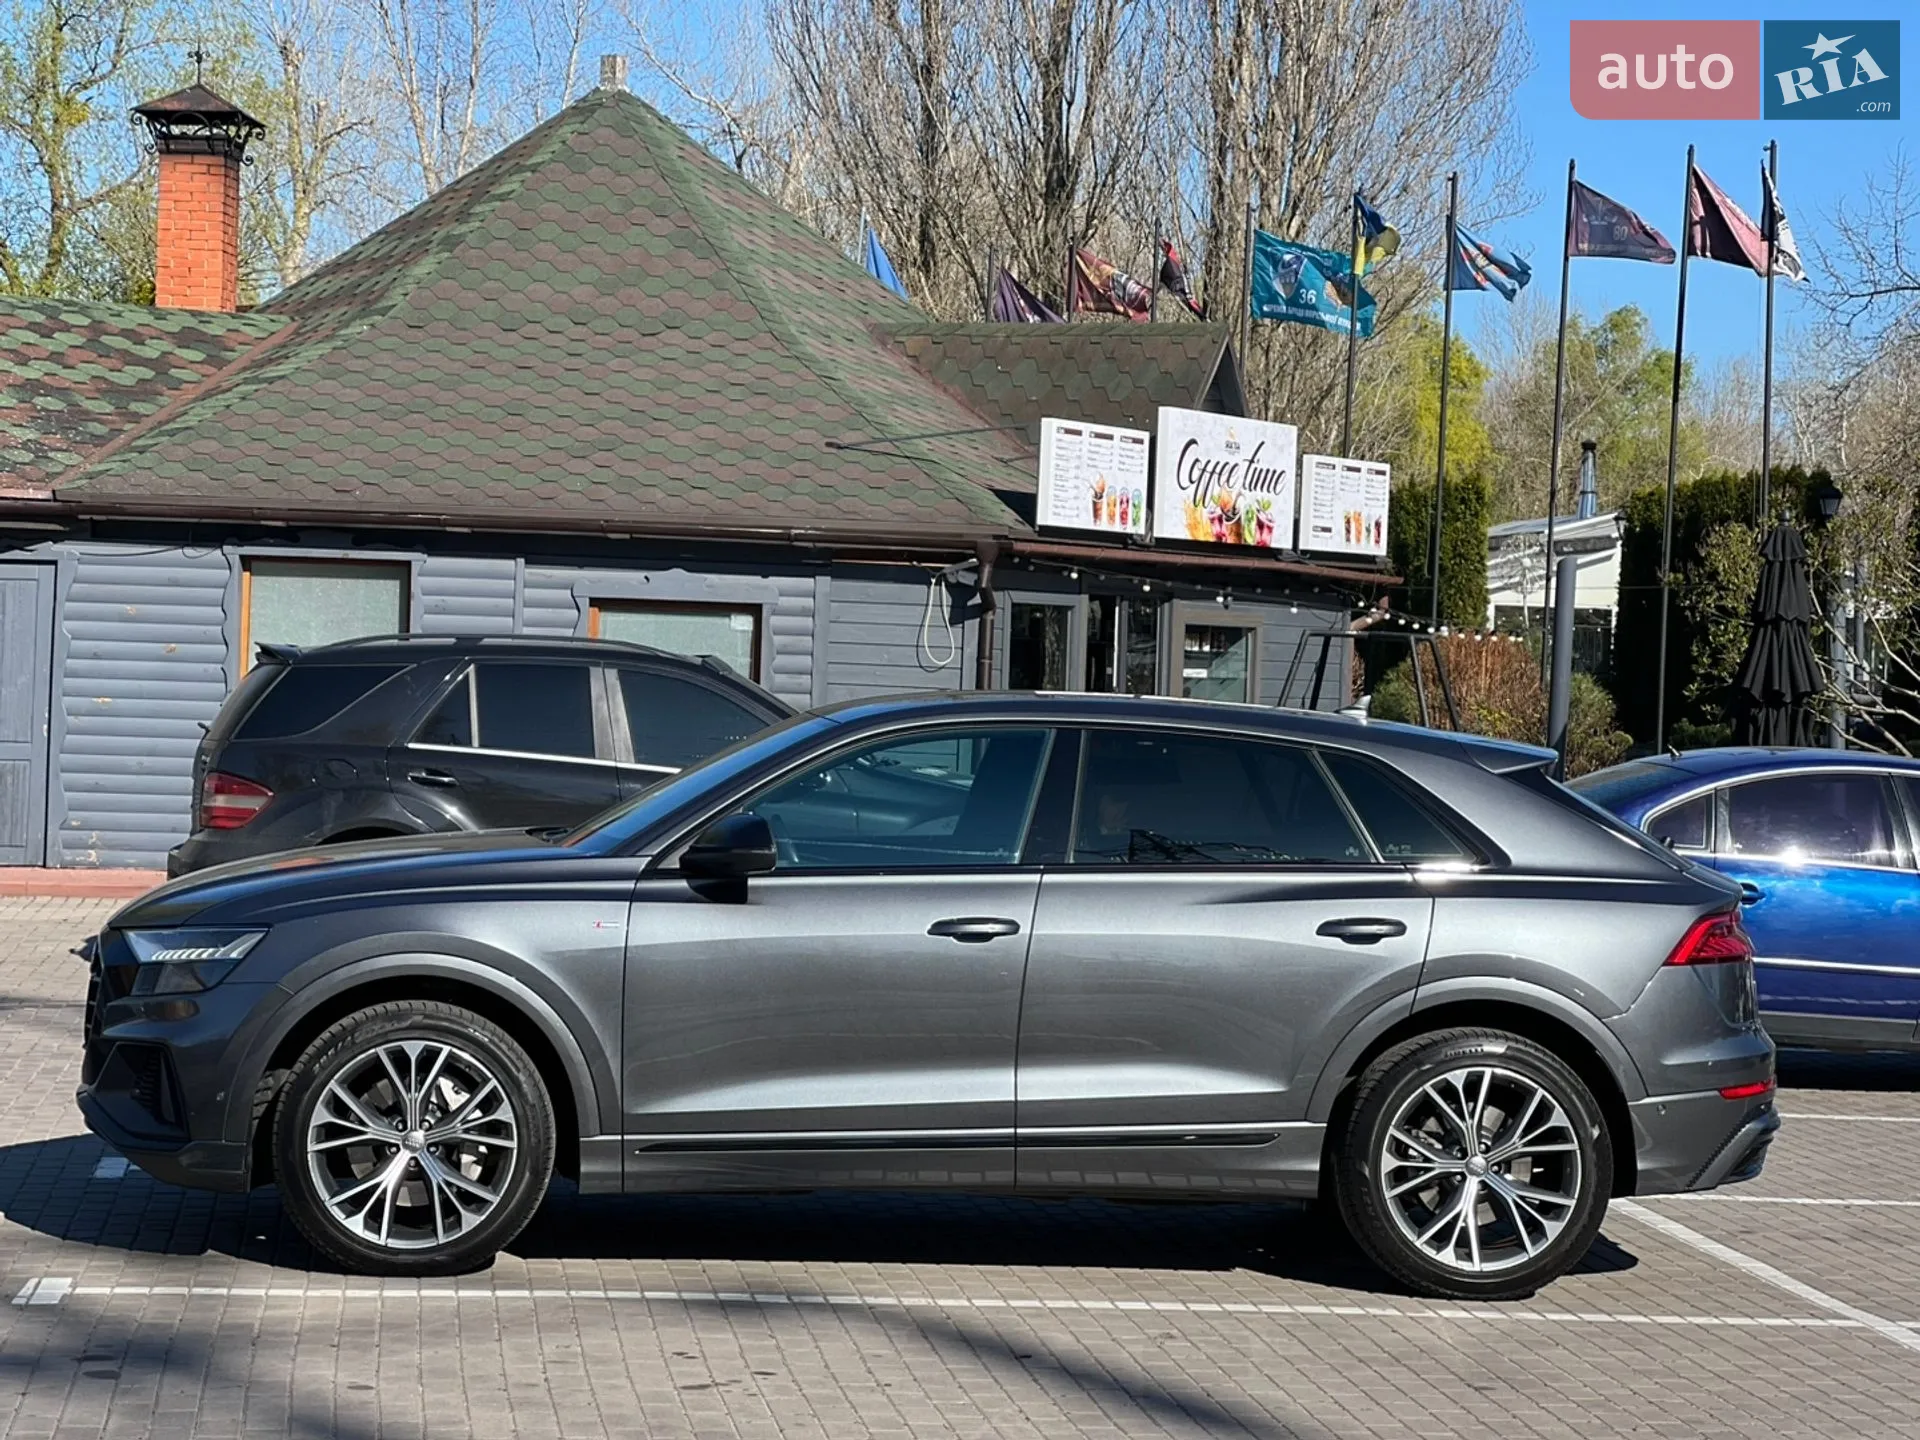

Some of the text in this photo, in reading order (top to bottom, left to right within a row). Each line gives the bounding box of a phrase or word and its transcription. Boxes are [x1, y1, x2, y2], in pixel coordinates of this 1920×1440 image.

[1299, 288, 1317, 304] 36
[1176, 438, 1240, 509] Coffee
[1242, 440, 1286, 496] time
